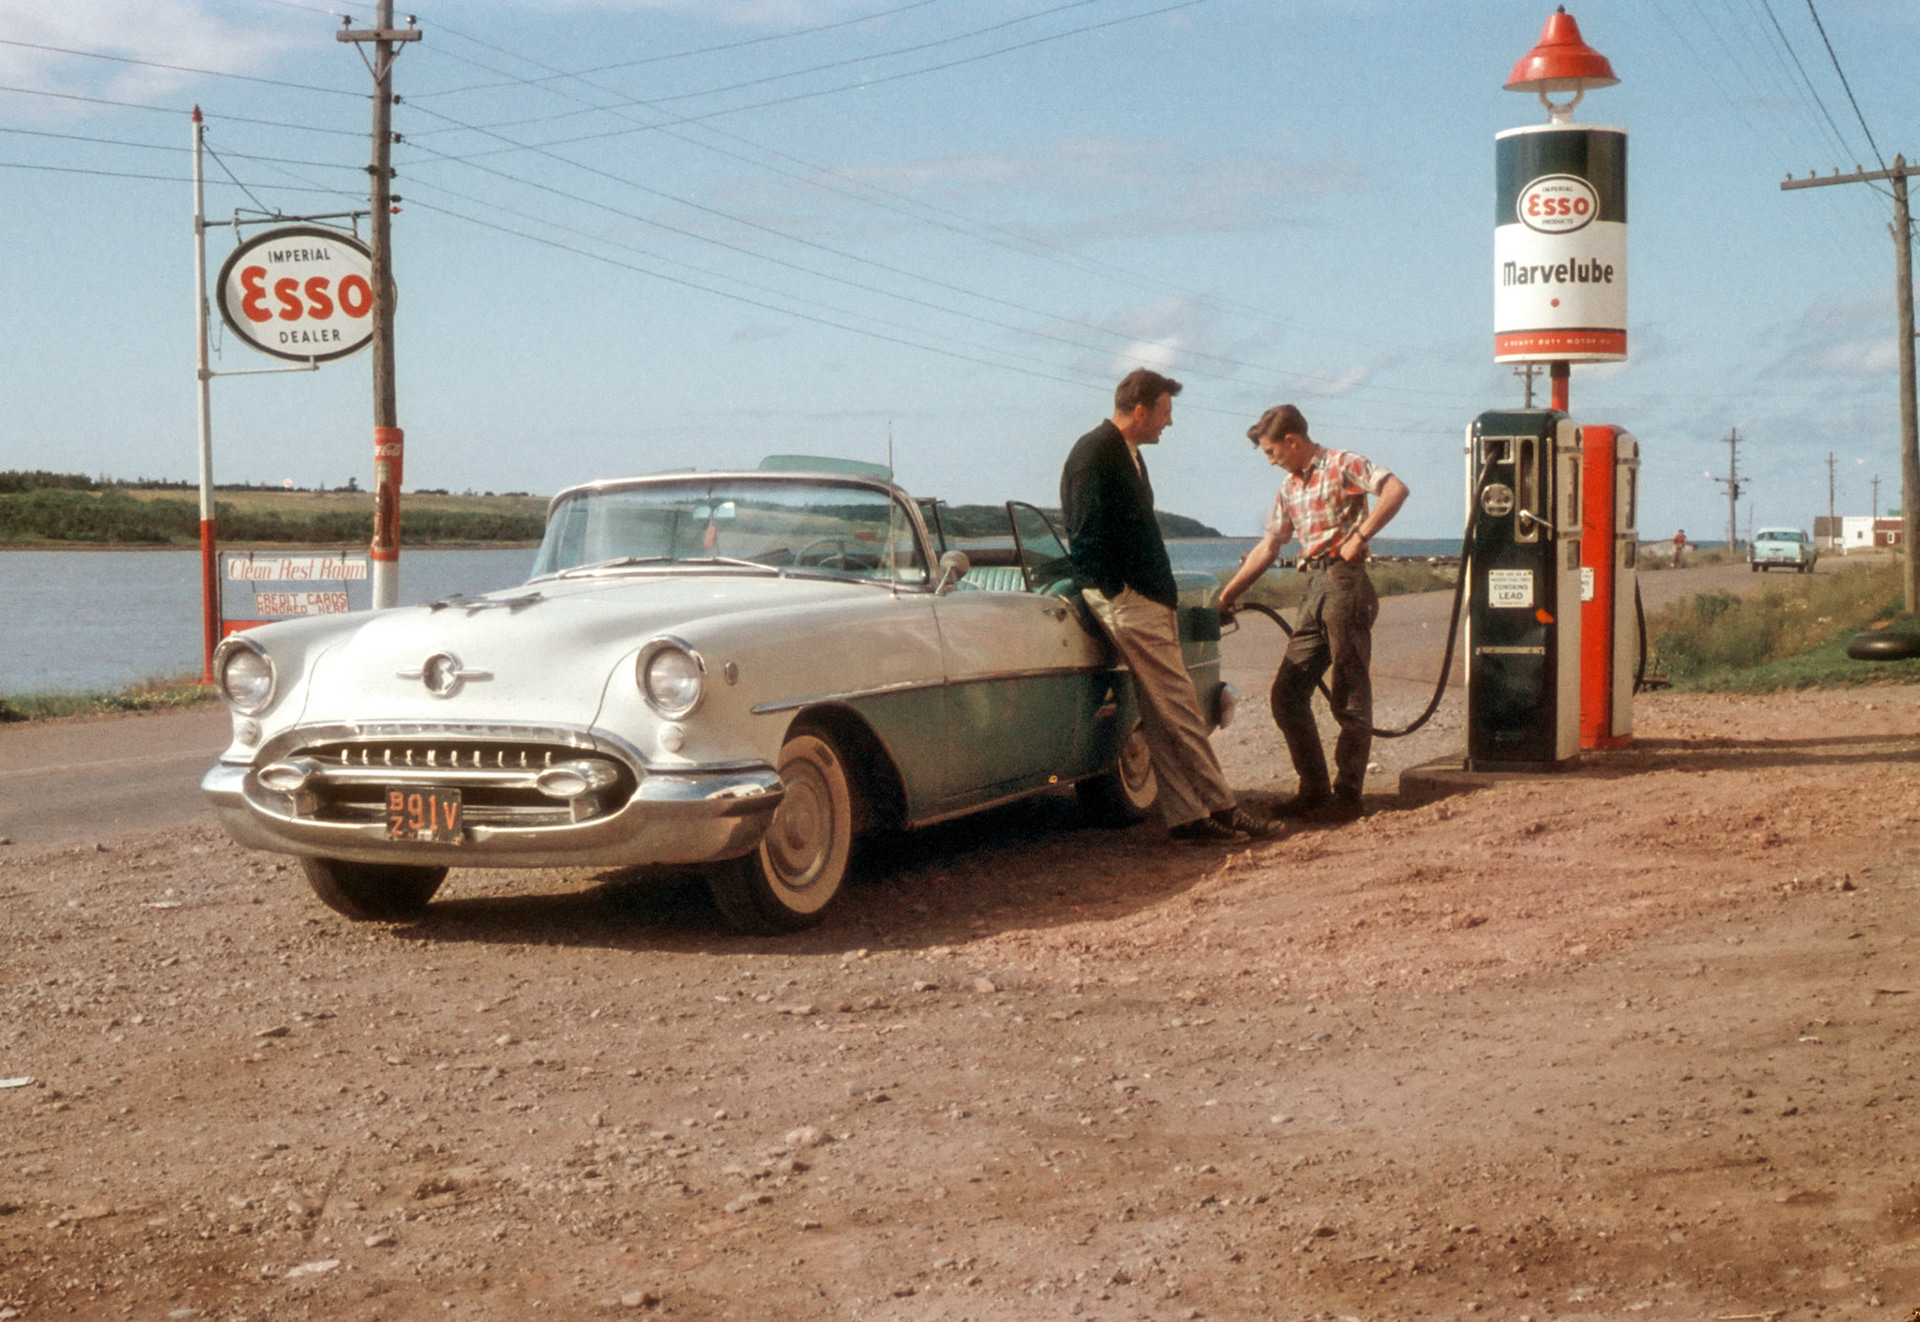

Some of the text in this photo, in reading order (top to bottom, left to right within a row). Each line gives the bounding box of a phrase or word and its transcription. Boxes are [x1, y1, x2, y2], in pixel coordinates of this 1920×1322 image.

[268, 248, 331, 263] IMPERIAL
[1503, 257, 1614, 287] Marvelube
[279, 329, 341, 344] DEALER
[230, 557, 365, 580] Clean Rest Room
[255, 592, 347, 606] CREDIT CARDS
[1499, 592, 1524, 600] LEAD
[256, 604, 348, 615] HONORED HERE
